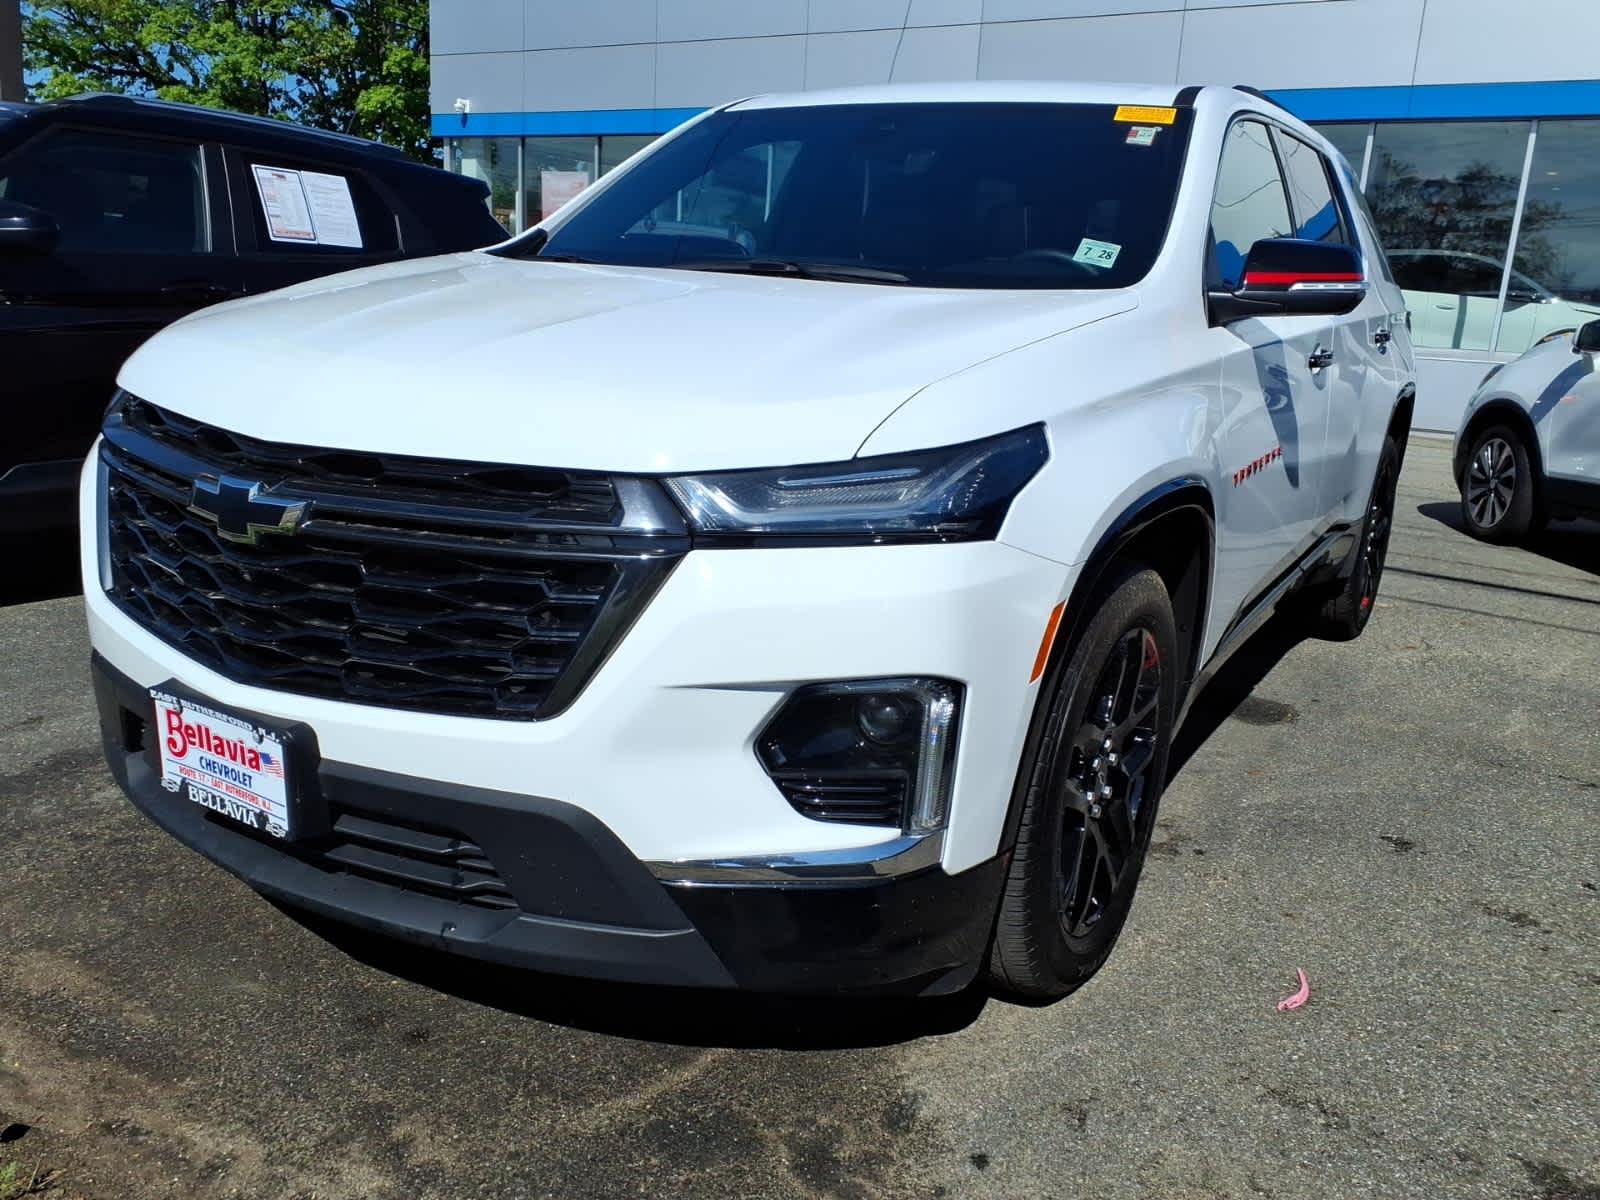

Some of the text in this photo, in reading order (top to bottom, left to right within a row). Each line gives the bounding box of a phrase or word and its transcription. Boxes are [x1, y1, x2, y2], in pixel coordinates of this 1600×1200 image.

[1083, 246, 1093, 256] 7
[1098, 249, 1113, 260] 28
[165, 709, 262, 772] Bellavia
[178, 766, 197, 778] ROUTE
[199, 756, 253, 789] CHEVROLET
[188, 785, 258, 828] BELLAVIA
